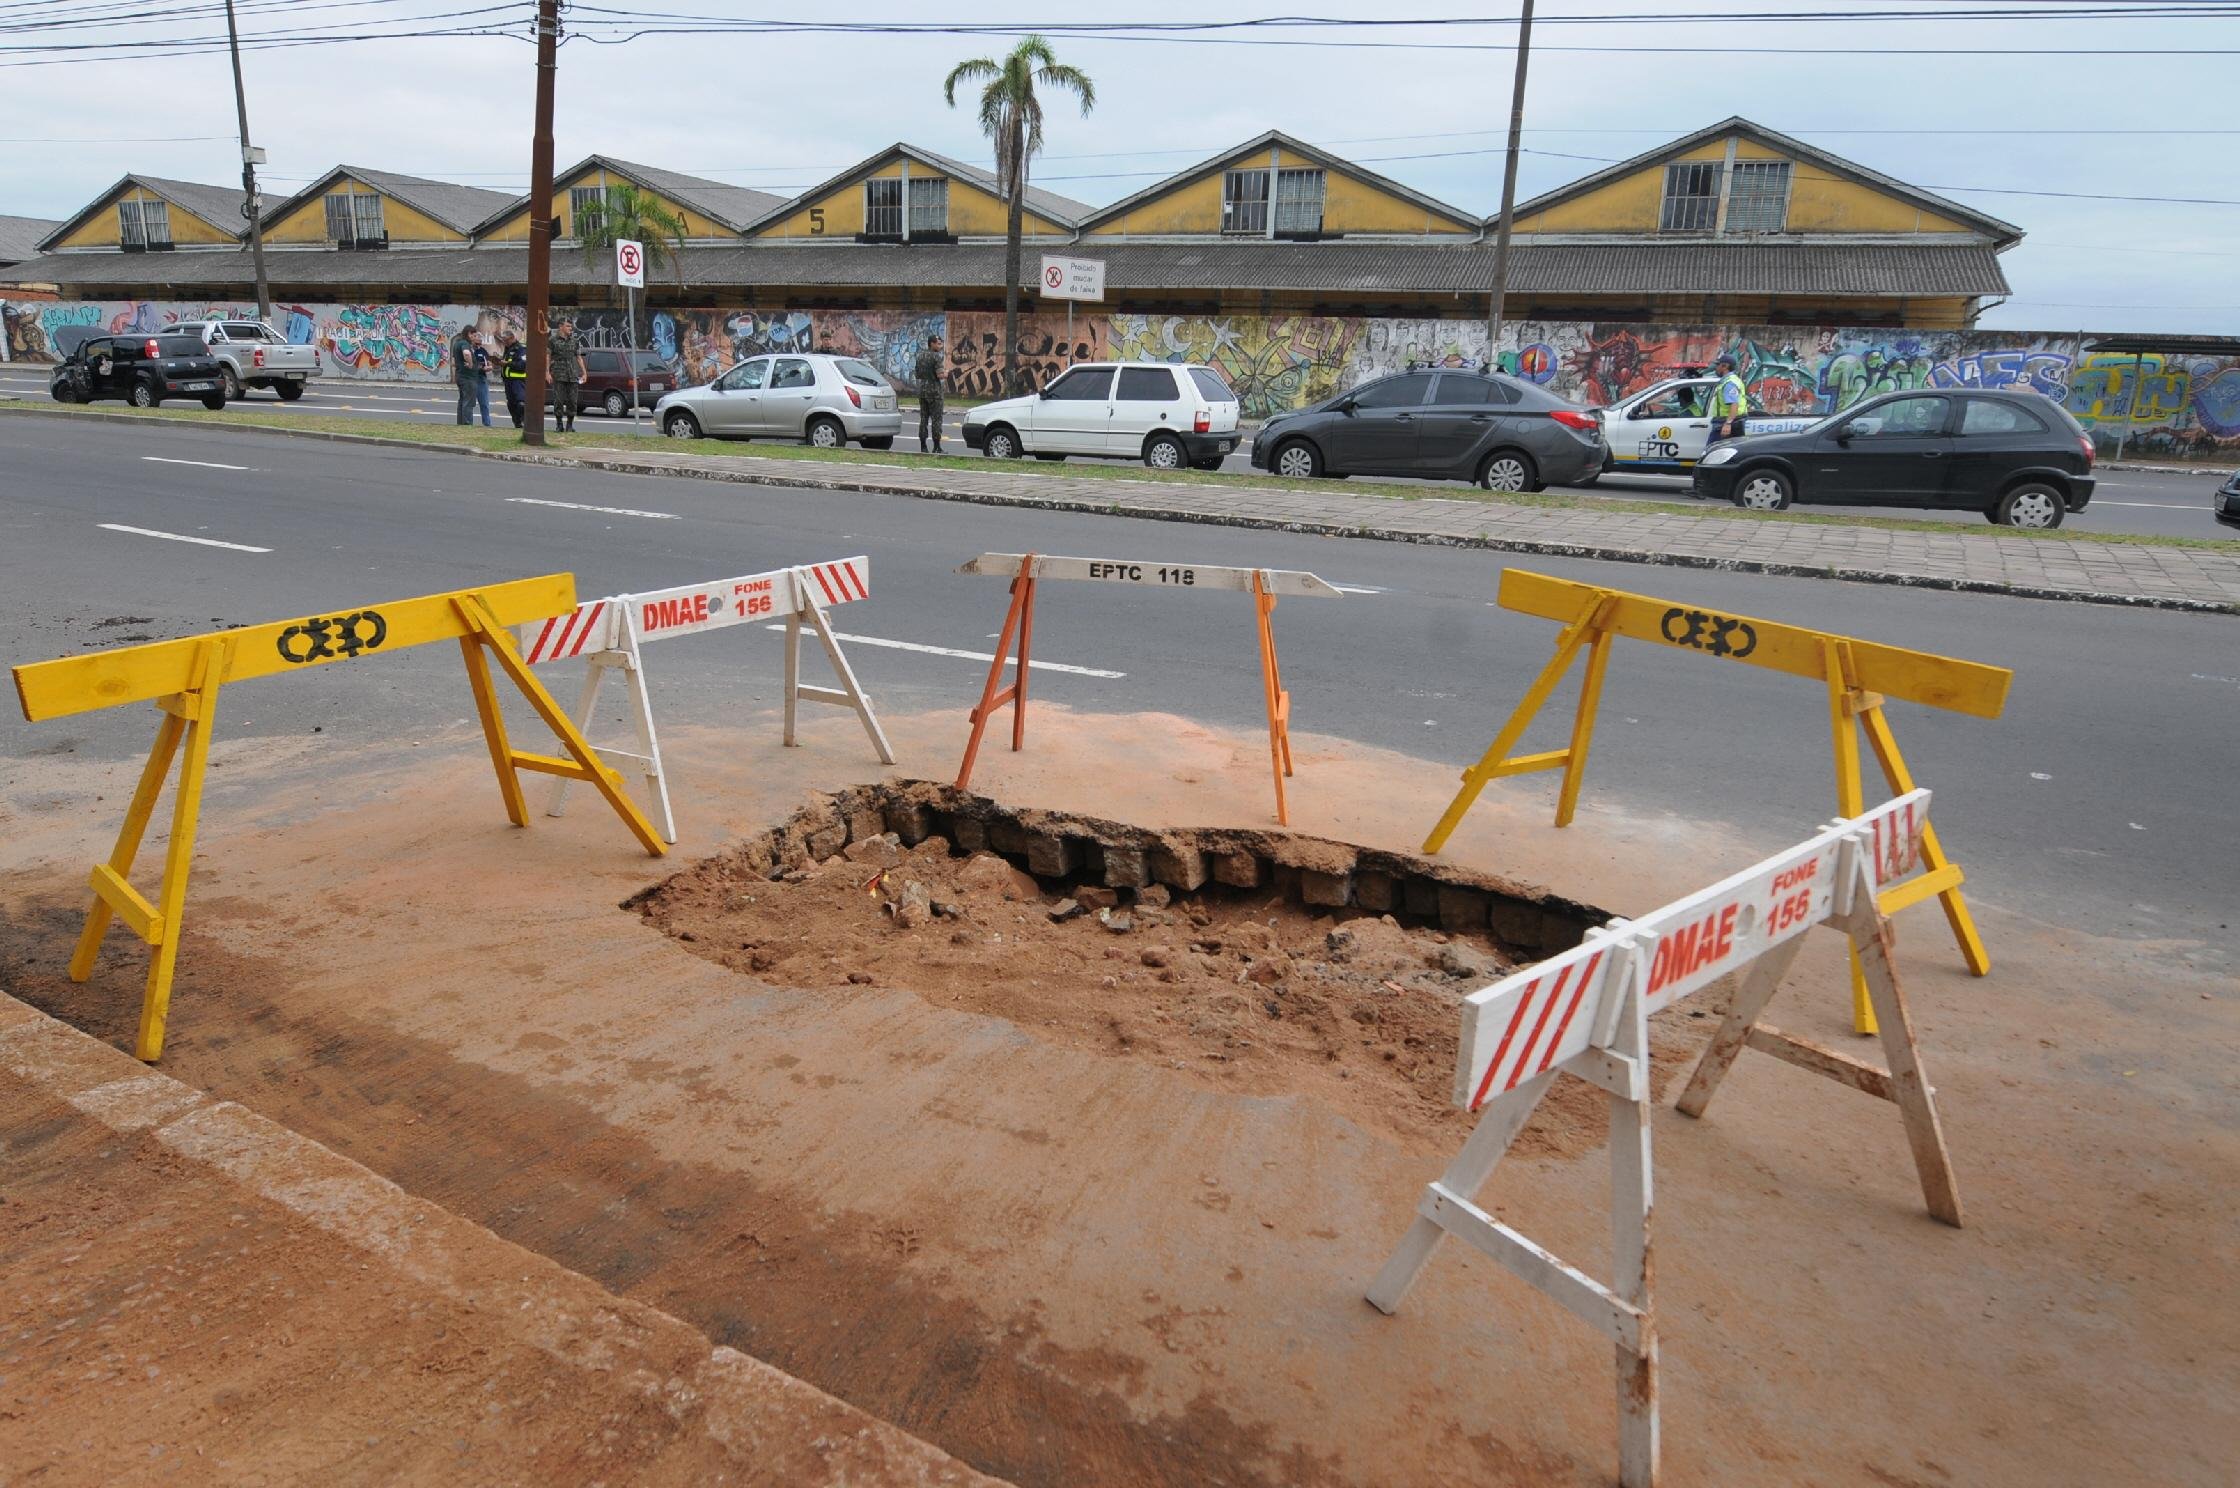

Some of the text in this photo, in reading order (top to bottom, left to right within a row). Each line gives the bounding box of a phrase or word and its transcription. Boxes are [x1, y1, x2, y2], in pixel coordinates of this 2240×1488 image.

[810, 209, 824, 234] 5
[1070, 285, 1078, 293] de
[1638, 440, 1679, 457] EPTC
[1089, 563, 1195, 586] EPTC 118
[734, 579, 773, 596] FONE
[643, 594, 708, 632] DMAE
[1771, 857, 1819, 897] FONE
[1646, 903, 1738, 996] DMAE
